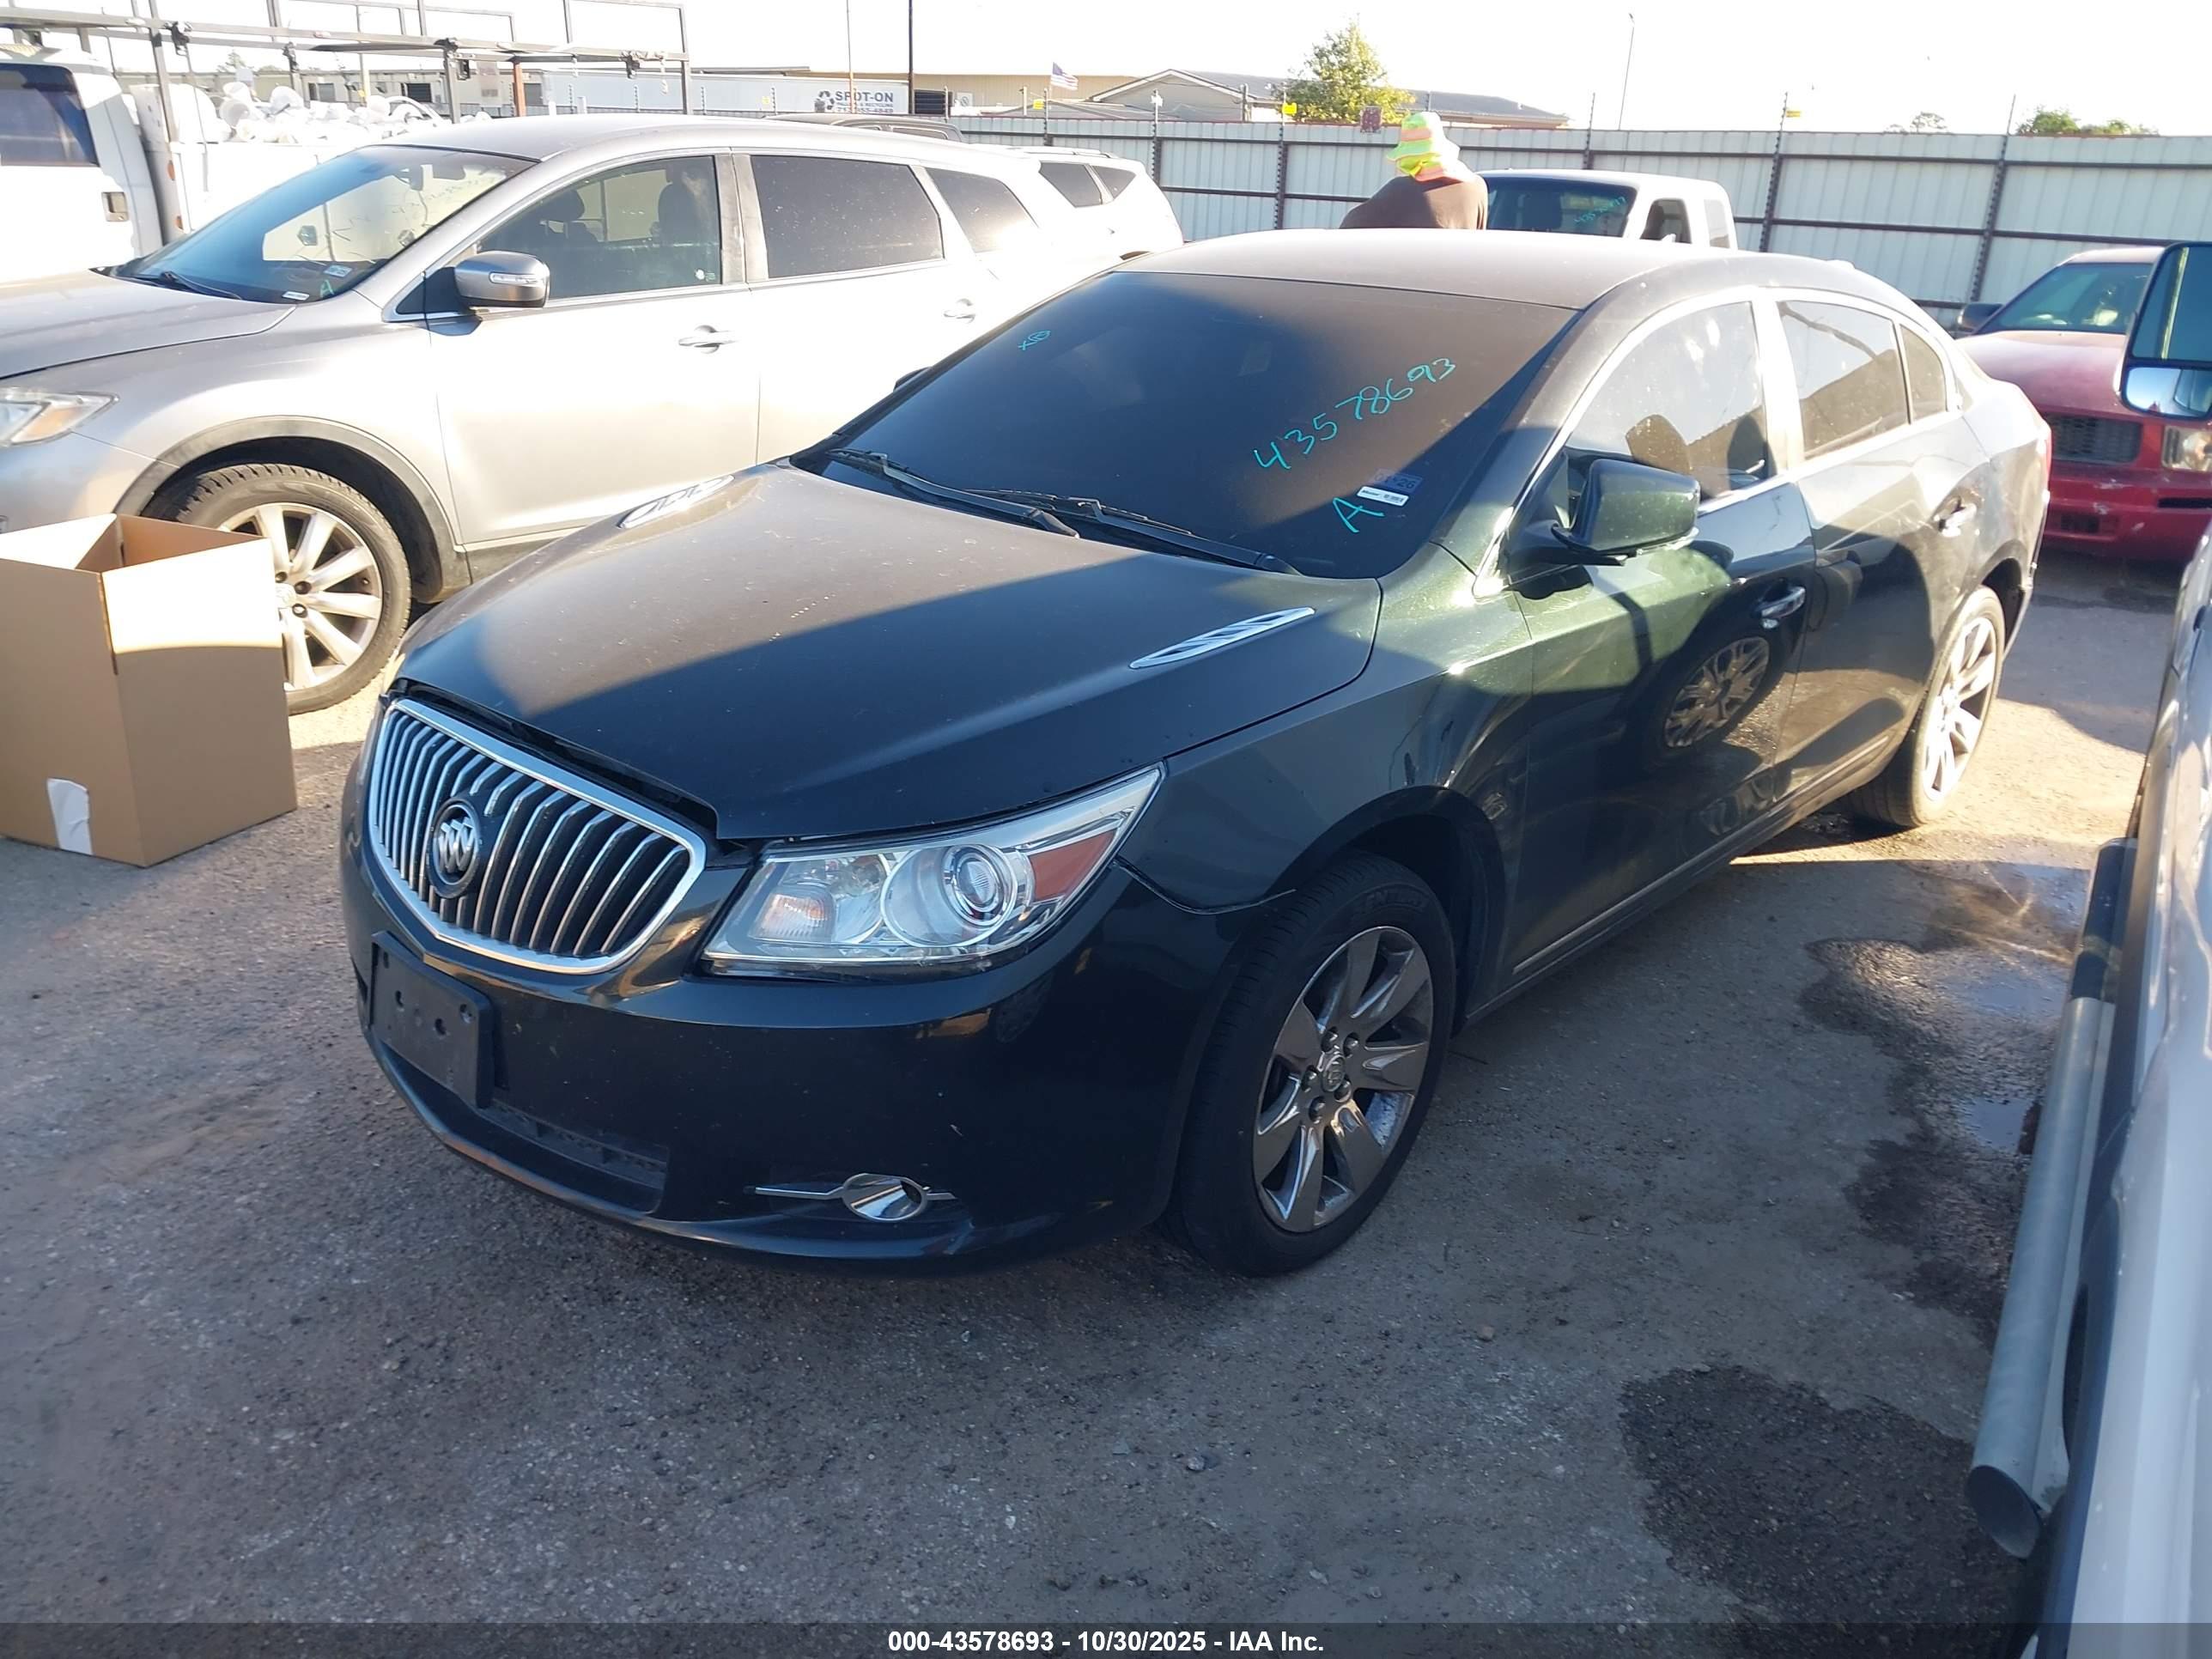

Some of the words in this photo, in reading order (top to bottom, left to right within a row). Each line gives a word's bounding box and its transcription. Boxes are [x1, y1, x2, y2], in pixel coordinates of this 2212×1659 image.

[835, 91, 893, 102] SPOT-ON
[319, 279, 335, 297] A
[1253, 357, 1456, 469] 43578693
[1333, 497, 1385, 533] A
